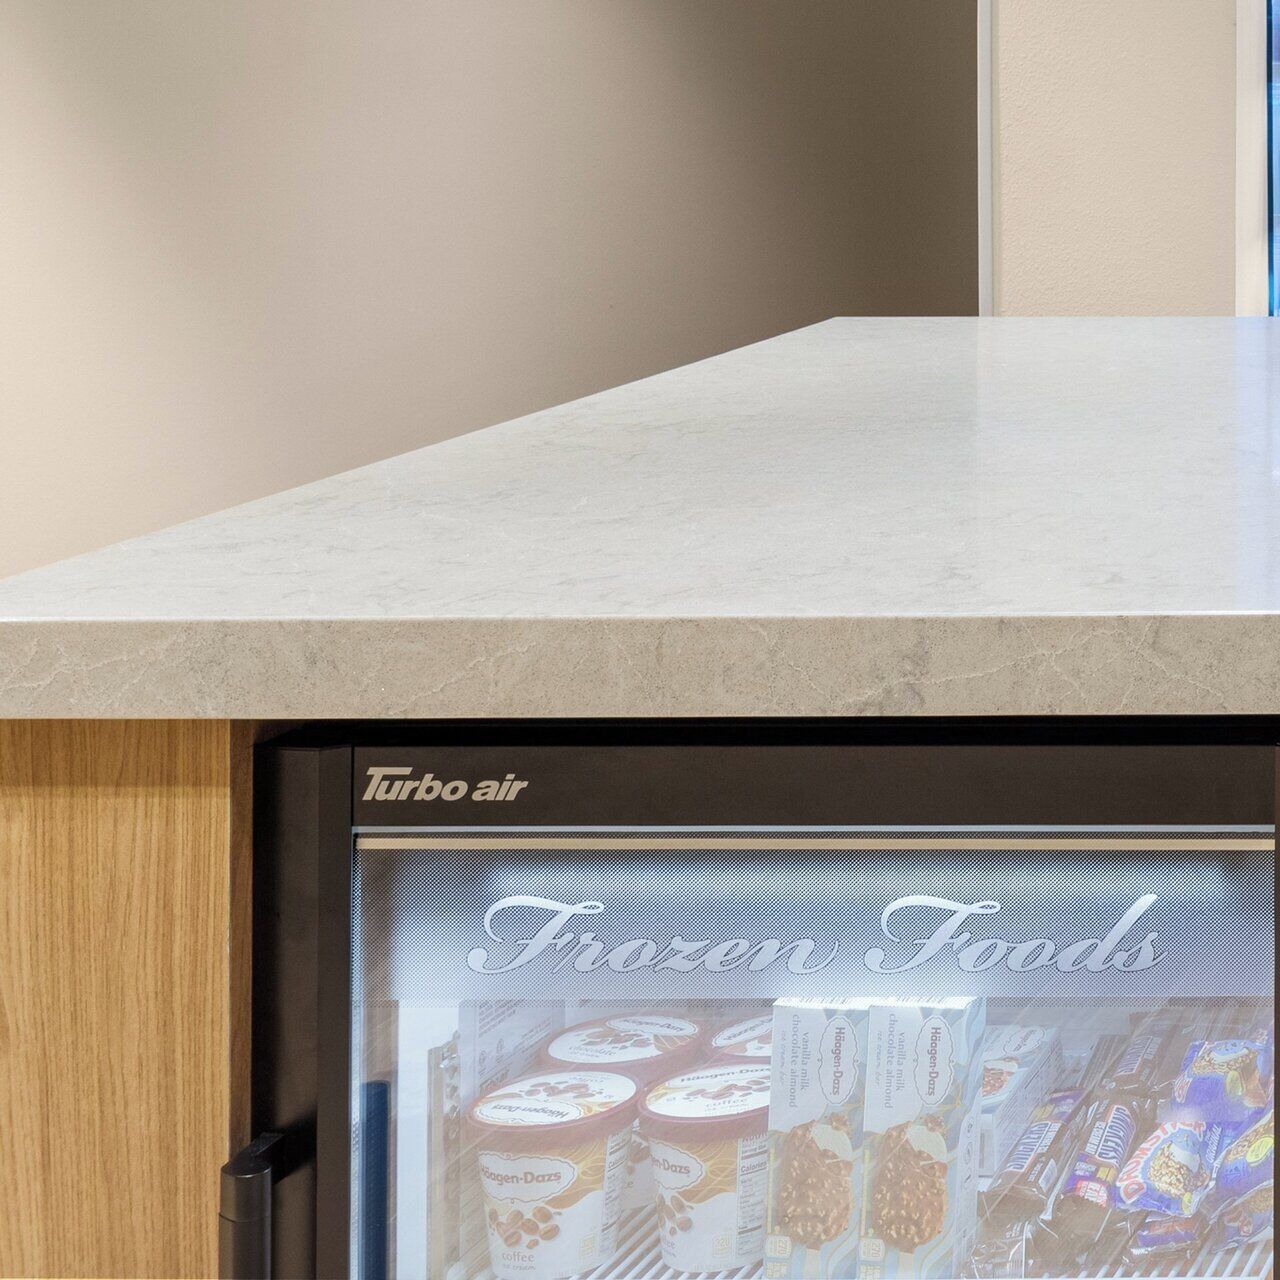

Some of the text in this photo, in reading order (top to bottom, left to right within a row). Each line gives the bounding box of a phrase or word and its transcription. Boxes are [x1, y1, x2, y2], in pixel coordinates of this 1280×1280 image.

[362, 767, 529, 801] Turbo air
[467, 892, 1168, 975] Frozen Foods
[788, 1014, 800, 1109] chocolate almond
[799, 1031, 811, 1092] vanilla milk
[832, 1026, 846, 1096] Häagen-Dazs
[884, 1014, 896, 1109] chocolate almond
[894, 1031, 906, 1092] vanilla milk
[927, 1026, 942, 1097] Häagen-Dazs
[501, 1251, 535, 1264] coffee
